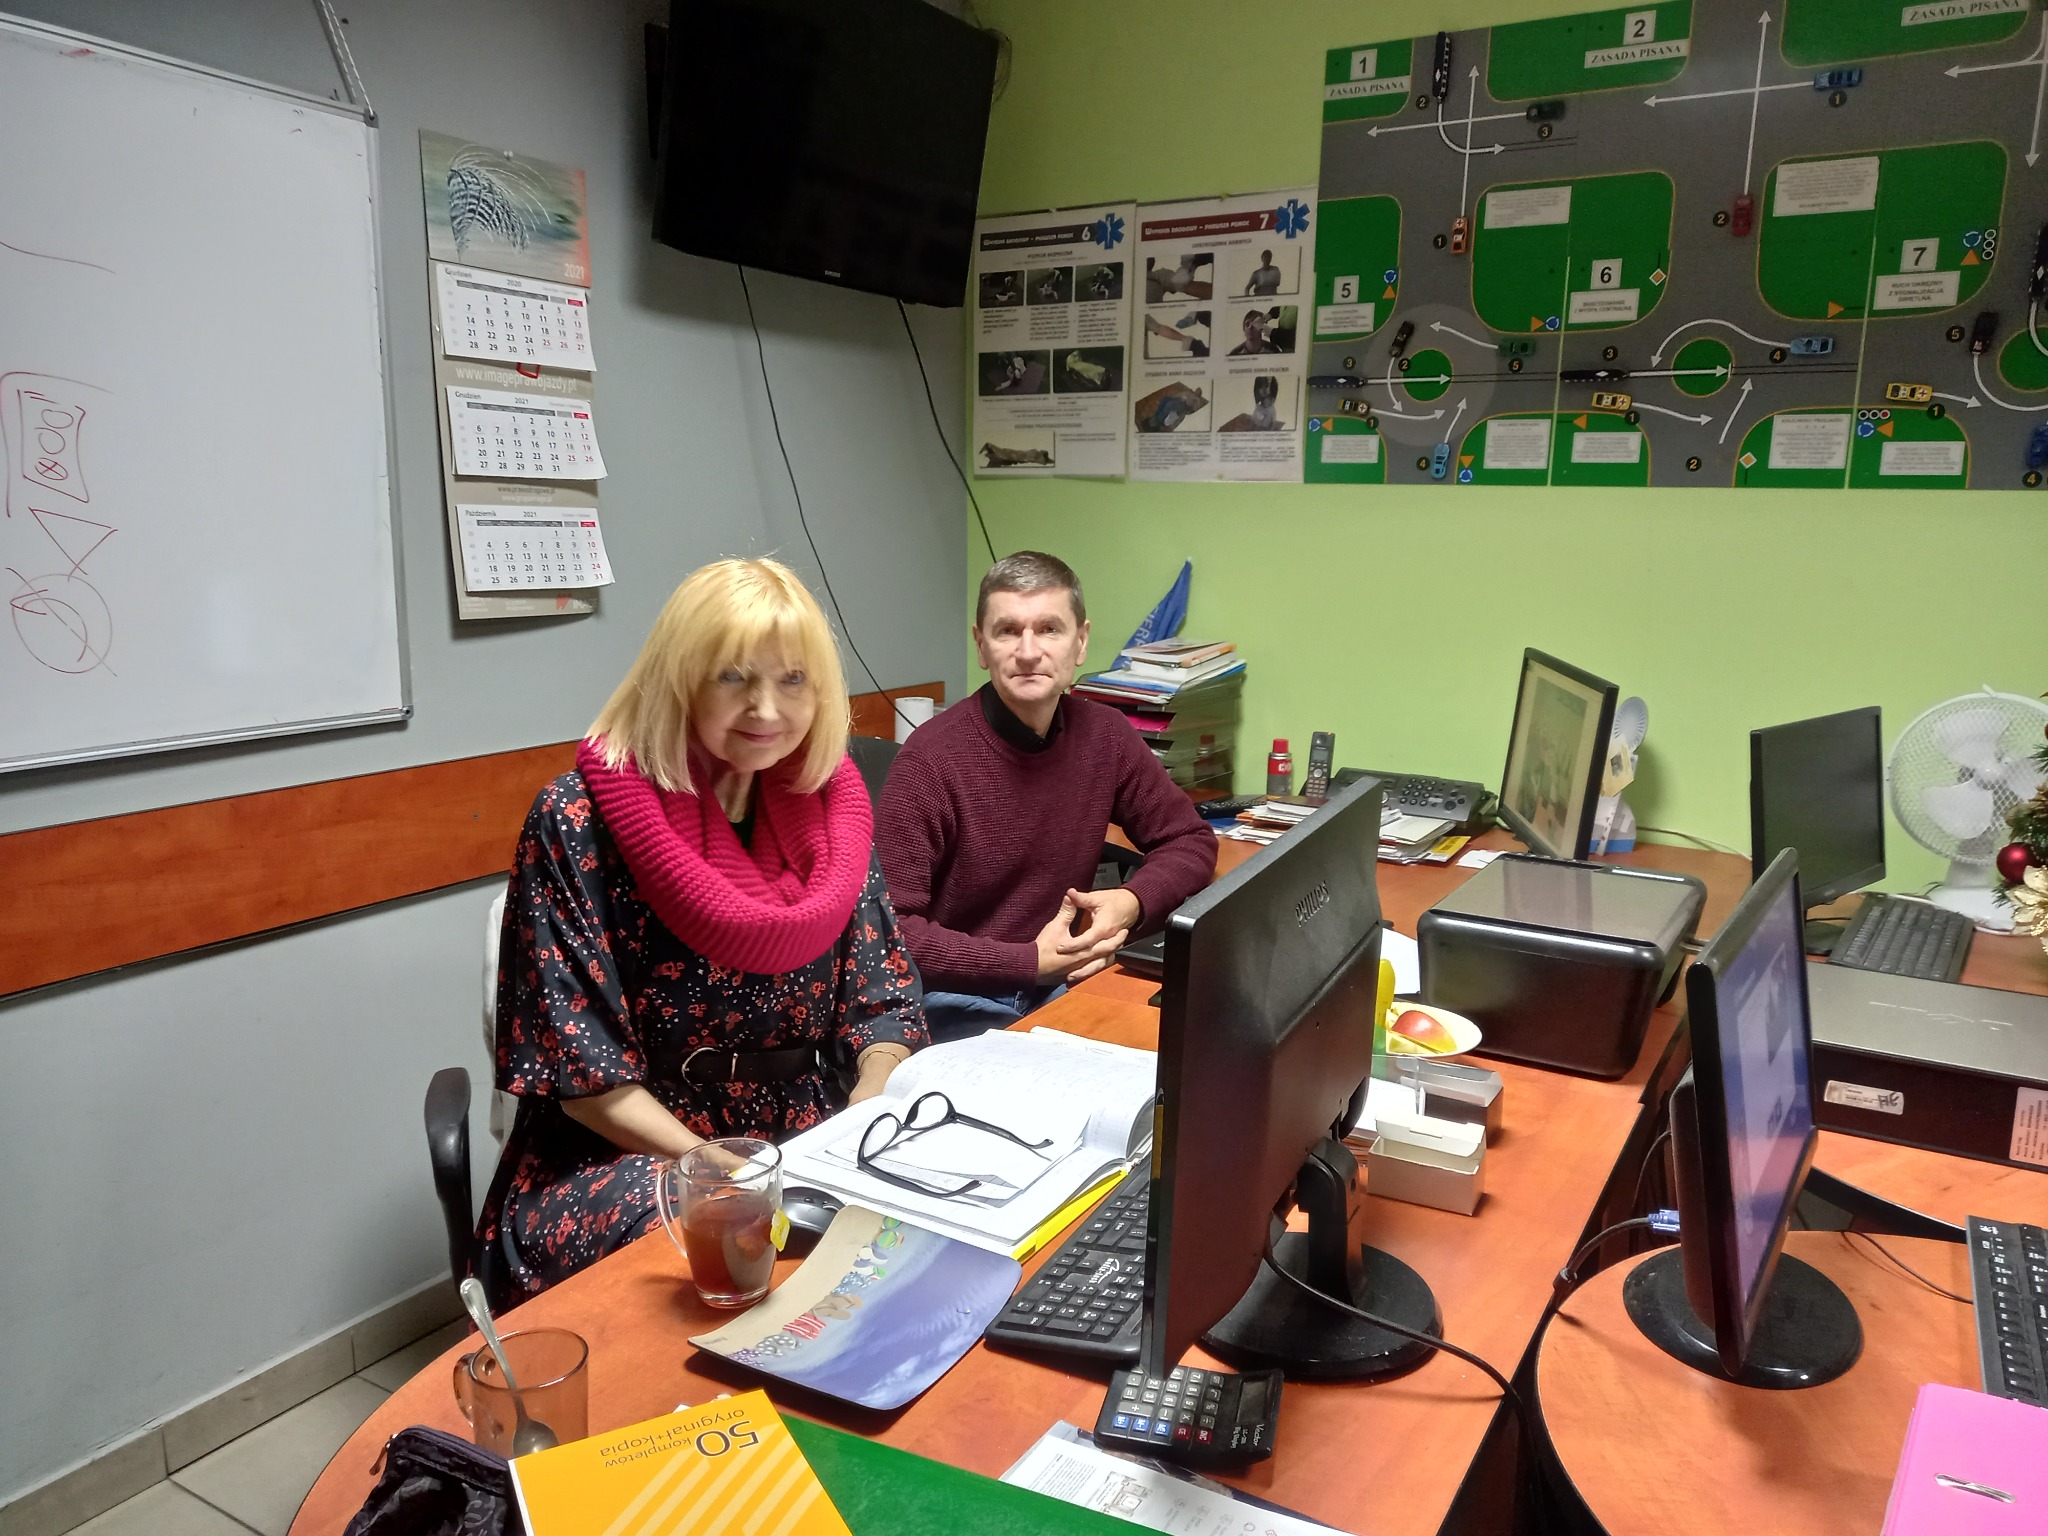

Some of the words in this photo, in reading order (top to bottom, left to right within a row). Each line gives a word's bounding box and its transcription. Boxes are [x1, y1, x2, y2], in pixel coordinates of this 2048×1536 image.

[1909, 5, 1964, 22] ZASADA
[1968, 0, 2020, 14] PISANA
[1633, 20, 1646, 38] 2
[1591, 50, 1637, 64] ZASADA
[1640, 44, 1681, 59] PISANA
[1360, 58, 1368, 74] 1
[1330, 86, 1367, 96] ZASADA
[1370, 82, 1404, 92] PISANA
[1420, 98, 1426, 106] 2
[1542, 127, 1548, 136] 3
[1260, 214, 1269, 230] 7
[1718, 214, 1726, 224] 2
[1082, 226, 1090, 240] 6
[1913, 247, 1927, 266] 7
[564, 264, 584, 279] 2021
[1600, 266, 1612, 283] 6
[1341, 283, 1352, 298] 5
[1952, 330, 1960, 340] 5
[1608, 349, 1614, 358] 3
[1774, 351, 1781, 360] 4
[1402, 360, 1408, 369] 2
[1513, 360, 1519, 370] 5
[1420, 460, 1426, 468] 4
[1690, 460, 1698, 469] 2
[2027, 474, 2036, 484] 4
[600, 1408, 744, 1458] oryginał+kopia
[695, 1420, 760, 1458] 50
[1253, 1424, 1264, 1446] Vector
[604, 1438, 692, 1468] kompletów
